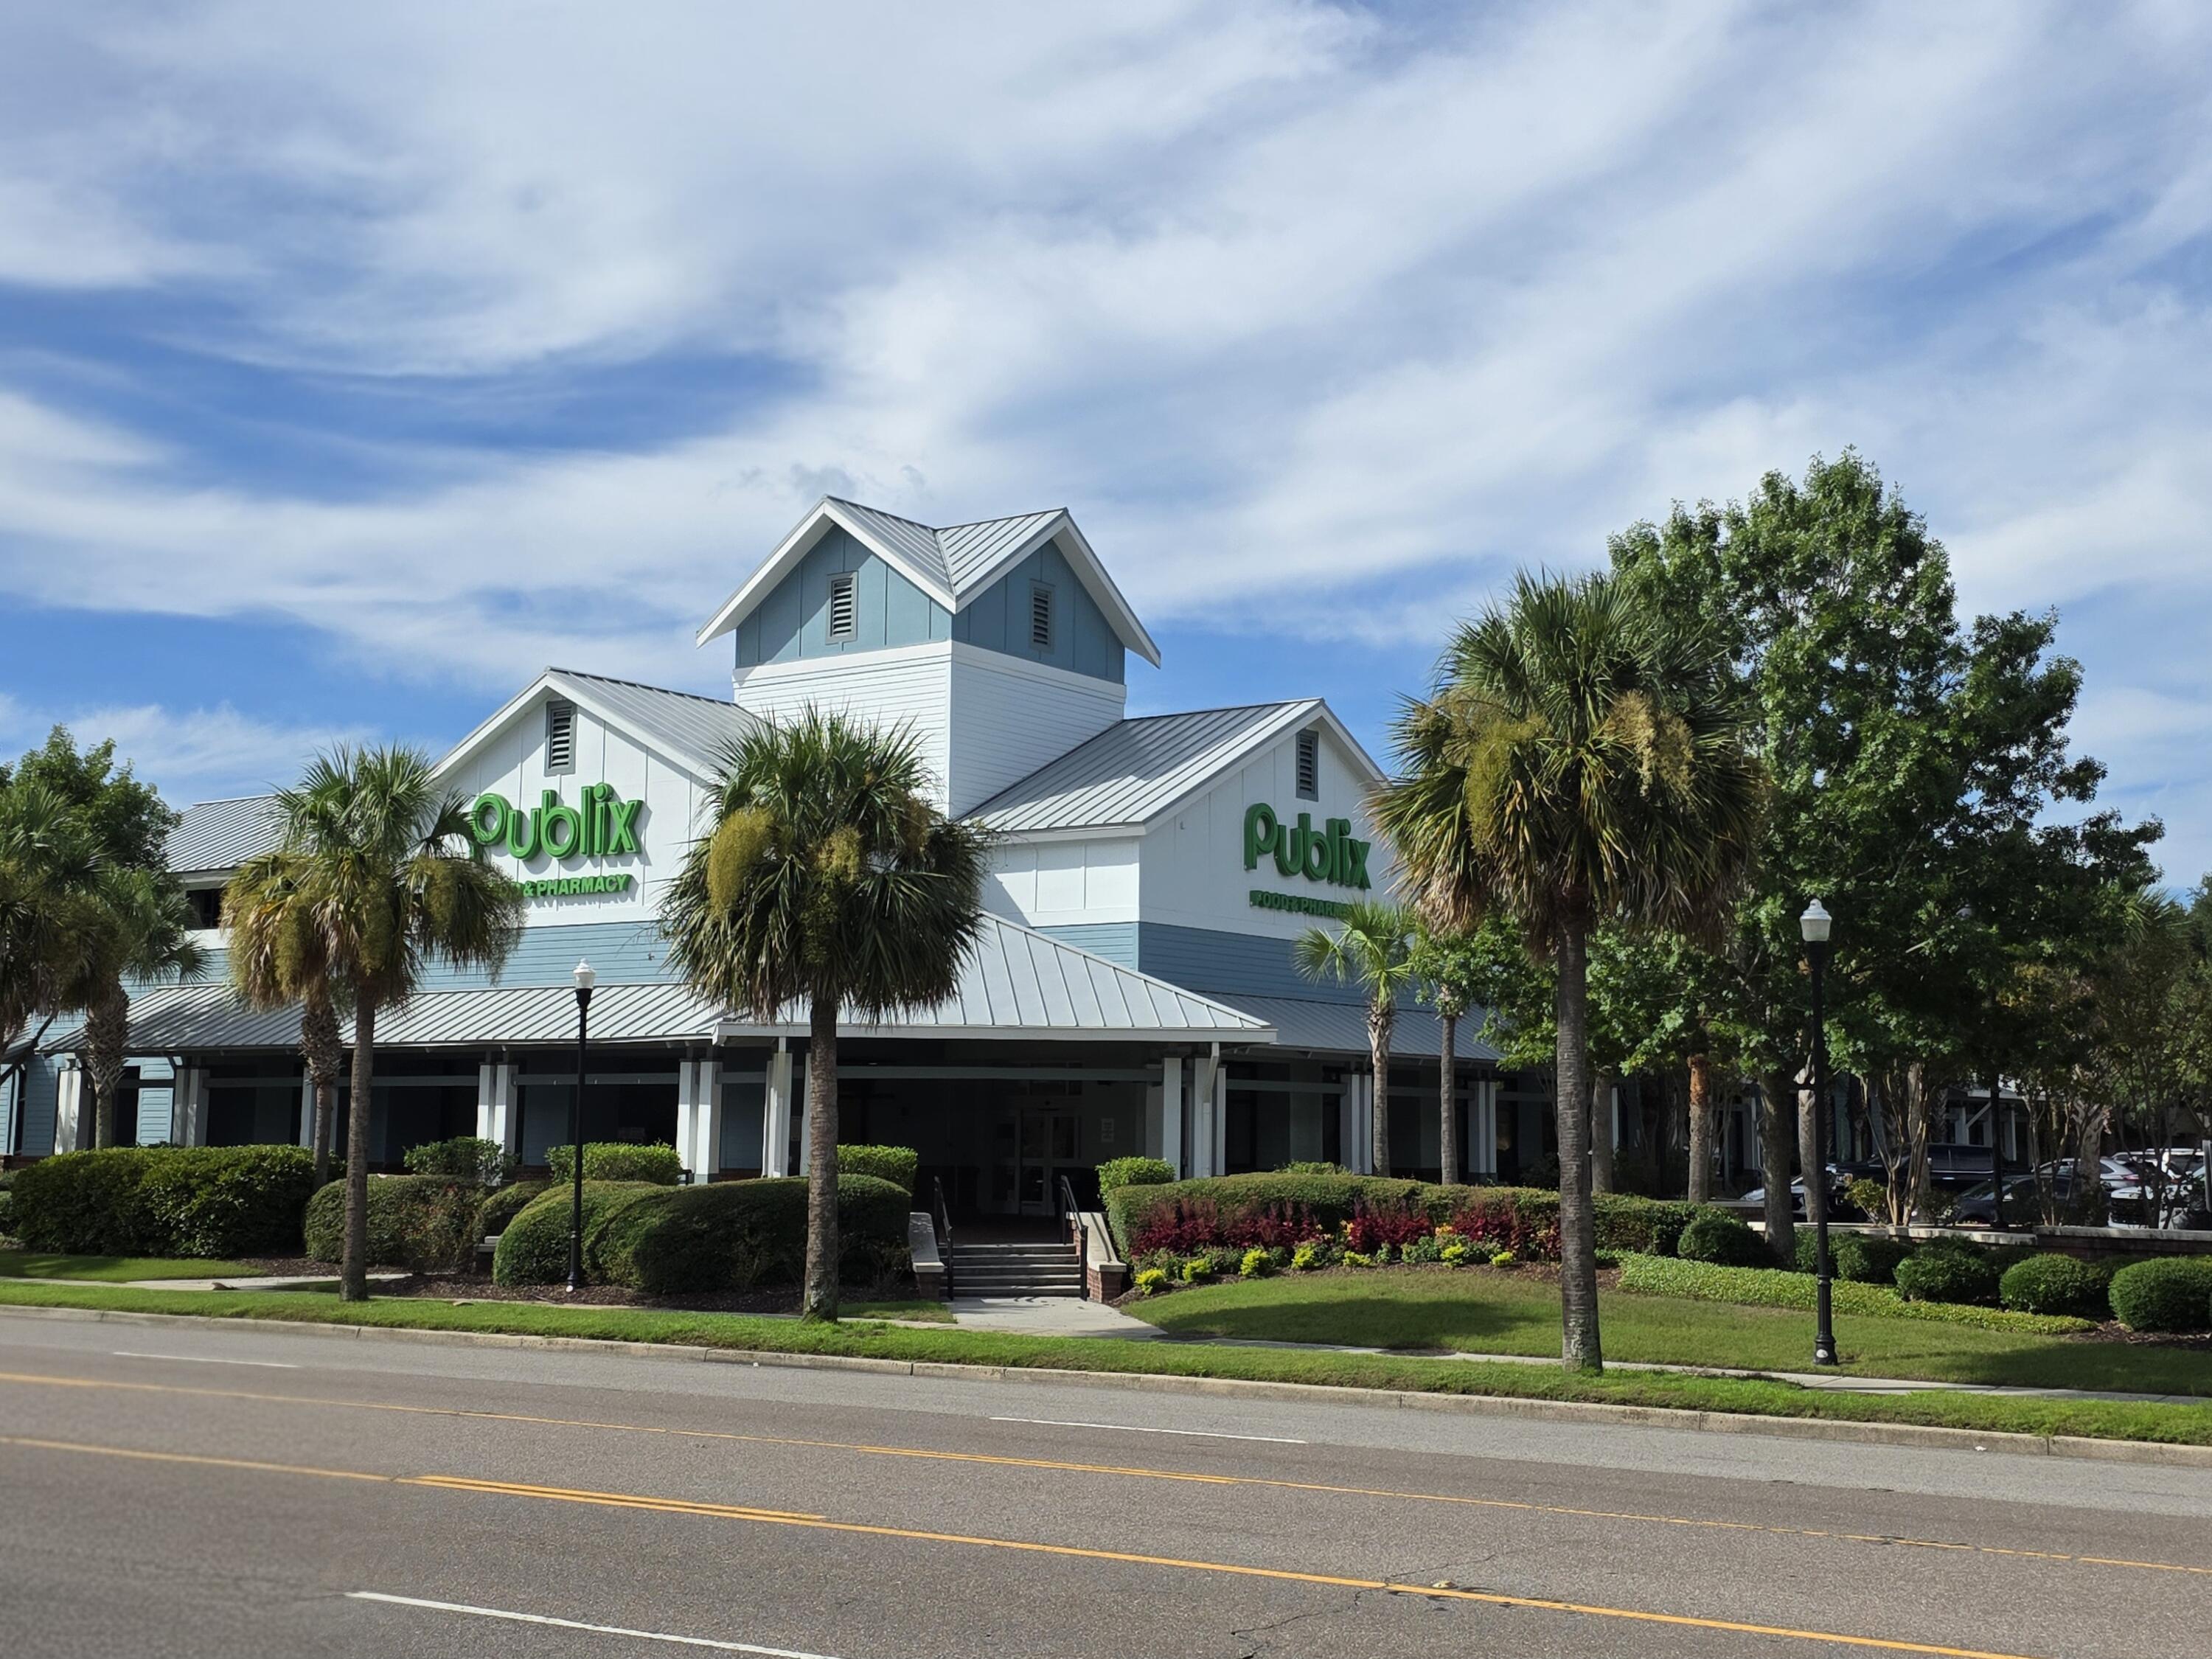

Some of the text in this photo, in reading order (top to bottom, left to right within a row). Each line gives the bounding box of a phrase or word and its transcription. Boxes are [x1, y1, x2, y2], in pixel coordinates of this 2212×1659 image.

[1244, 803, 1371, 890] Publix
[524, 880, 536, 897] &
[537, 874, 632, 897] PHARMACY
[1301, 897, 1350, 919] PHARM
